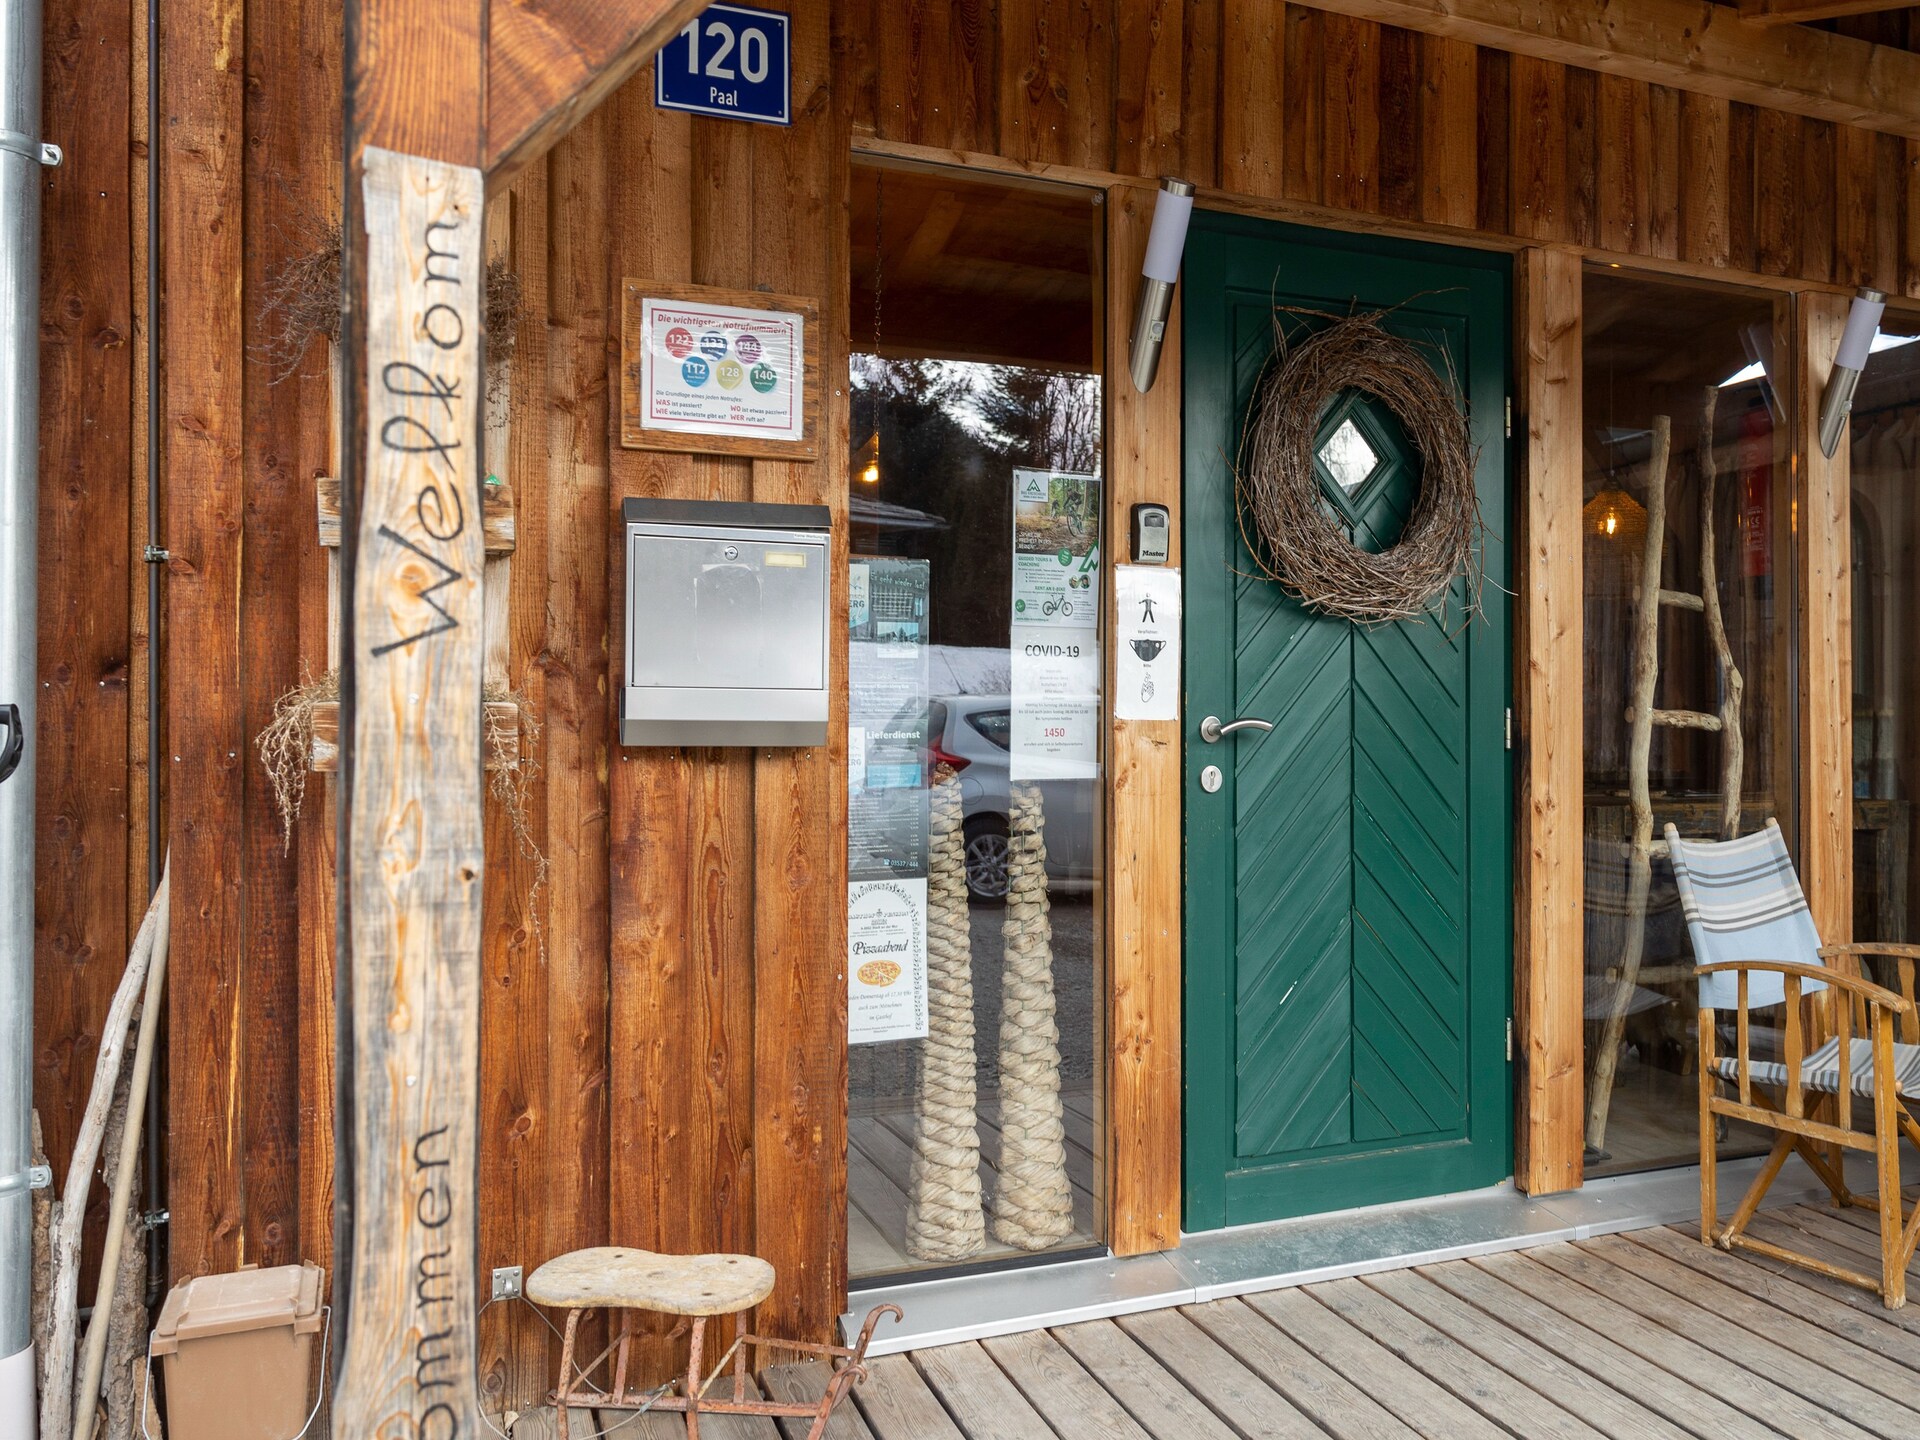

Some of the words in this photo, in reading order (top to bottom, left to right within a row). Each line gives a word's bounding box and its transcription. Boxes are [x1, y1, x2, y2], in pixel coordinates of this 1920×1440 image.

[681, 18, 768, 83] 120
[710, 86, 738, 107] Paal
[657, 313, 671, 323] Die
[673, 316, 721, 329] wichtigsten
[722, 321, 787, 335] Notrufnummern
[669, 334, 689, 345] 122
[686, 363, 706, 374] 112
[720, 367, 740, 377] 128
[754, 370, 773, 380] 140
[665, 390, 690, 399] Grundlage
[1142, 550, 1165, 558] Master
[1025, 644, 1080, 658] COVID-19
[867, 730, 921, 740] Lieferdienst
[1044, 727, 1065, 738] 1450
[852, 939, 909, 955] Pizzaabend
